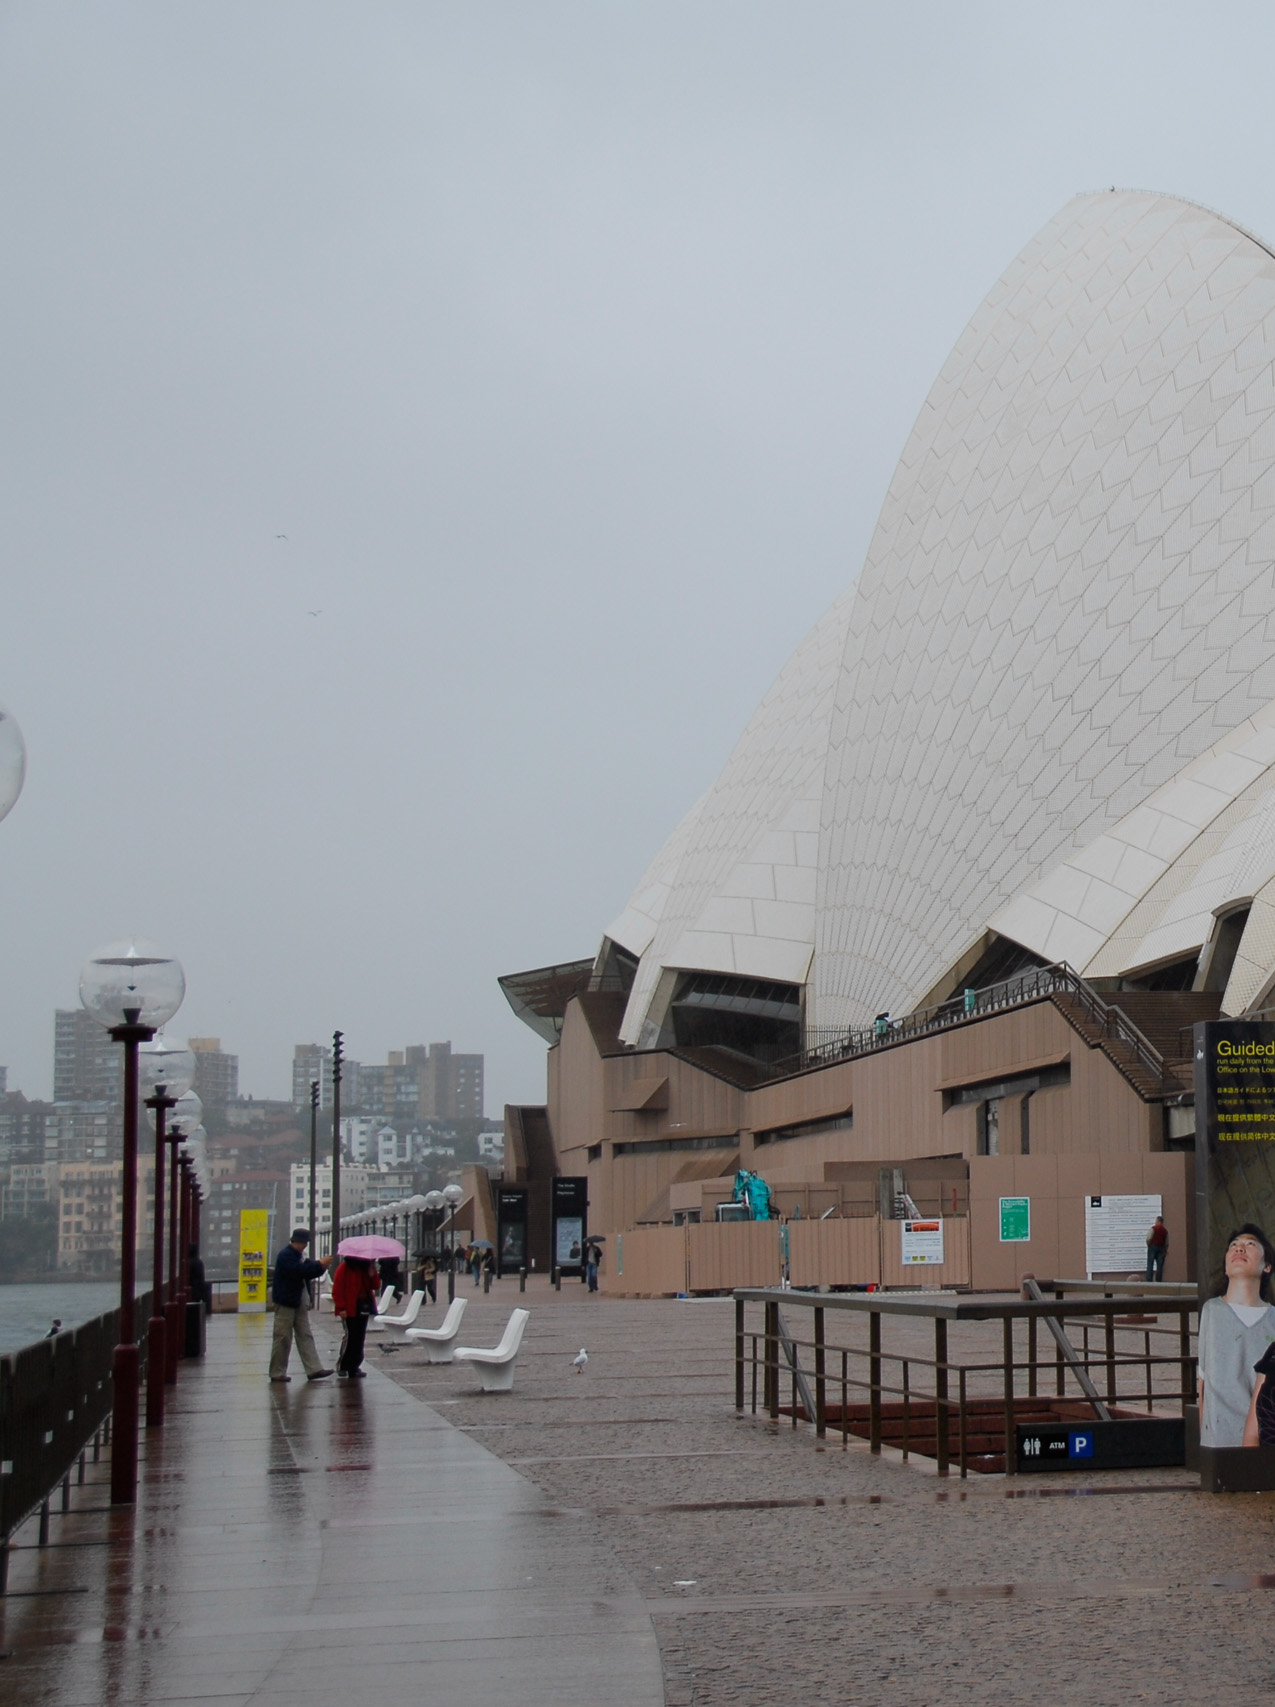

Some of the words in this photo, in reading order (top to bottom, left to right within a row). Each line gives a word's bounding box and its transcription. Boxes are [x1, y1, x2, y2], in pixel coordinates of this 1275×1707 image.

[1217, 1040, 1275, 1056] Guided
[1229, 1057, 1244, 1065] daily
[1246, 1057, 1262, 1065] from
[1075, 1437, 1087, 1453] P
